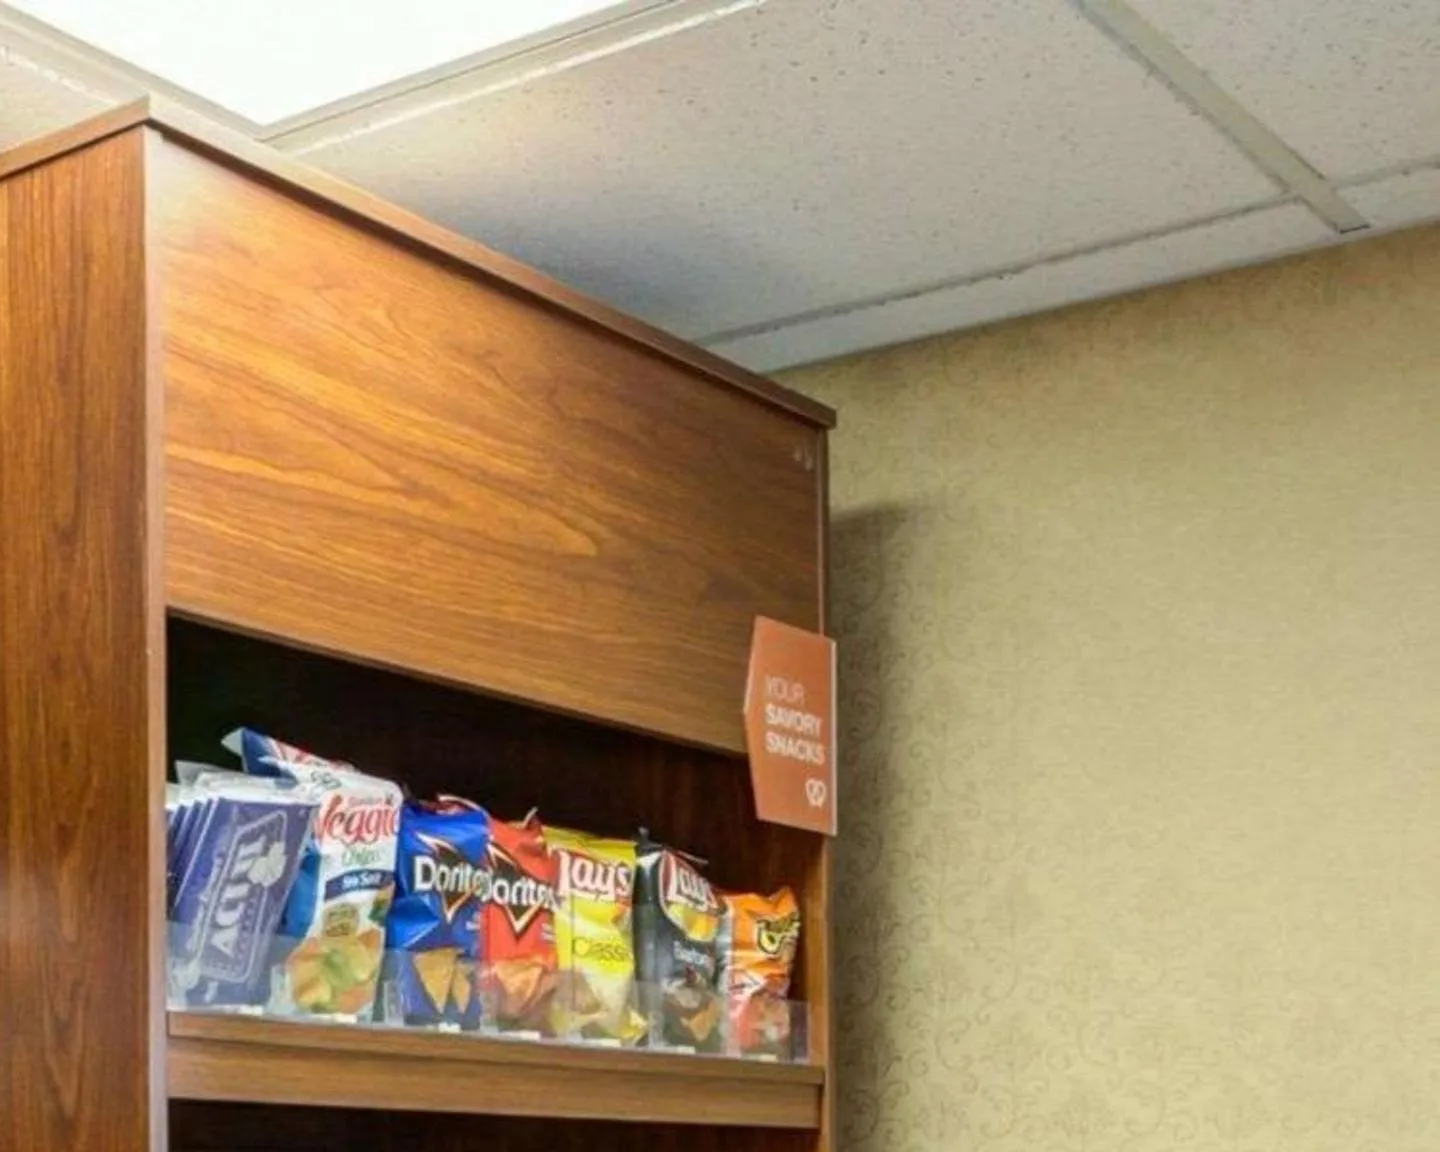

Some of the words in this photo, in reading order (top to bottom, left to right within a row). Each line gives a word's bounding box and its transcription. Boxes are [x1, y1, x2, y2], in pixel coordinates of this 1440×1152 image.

[765, 675, 806, 706] YOUR
[765, 703, 823, 738] SAVORY
[765, 731, 826, 765] SNACKS
